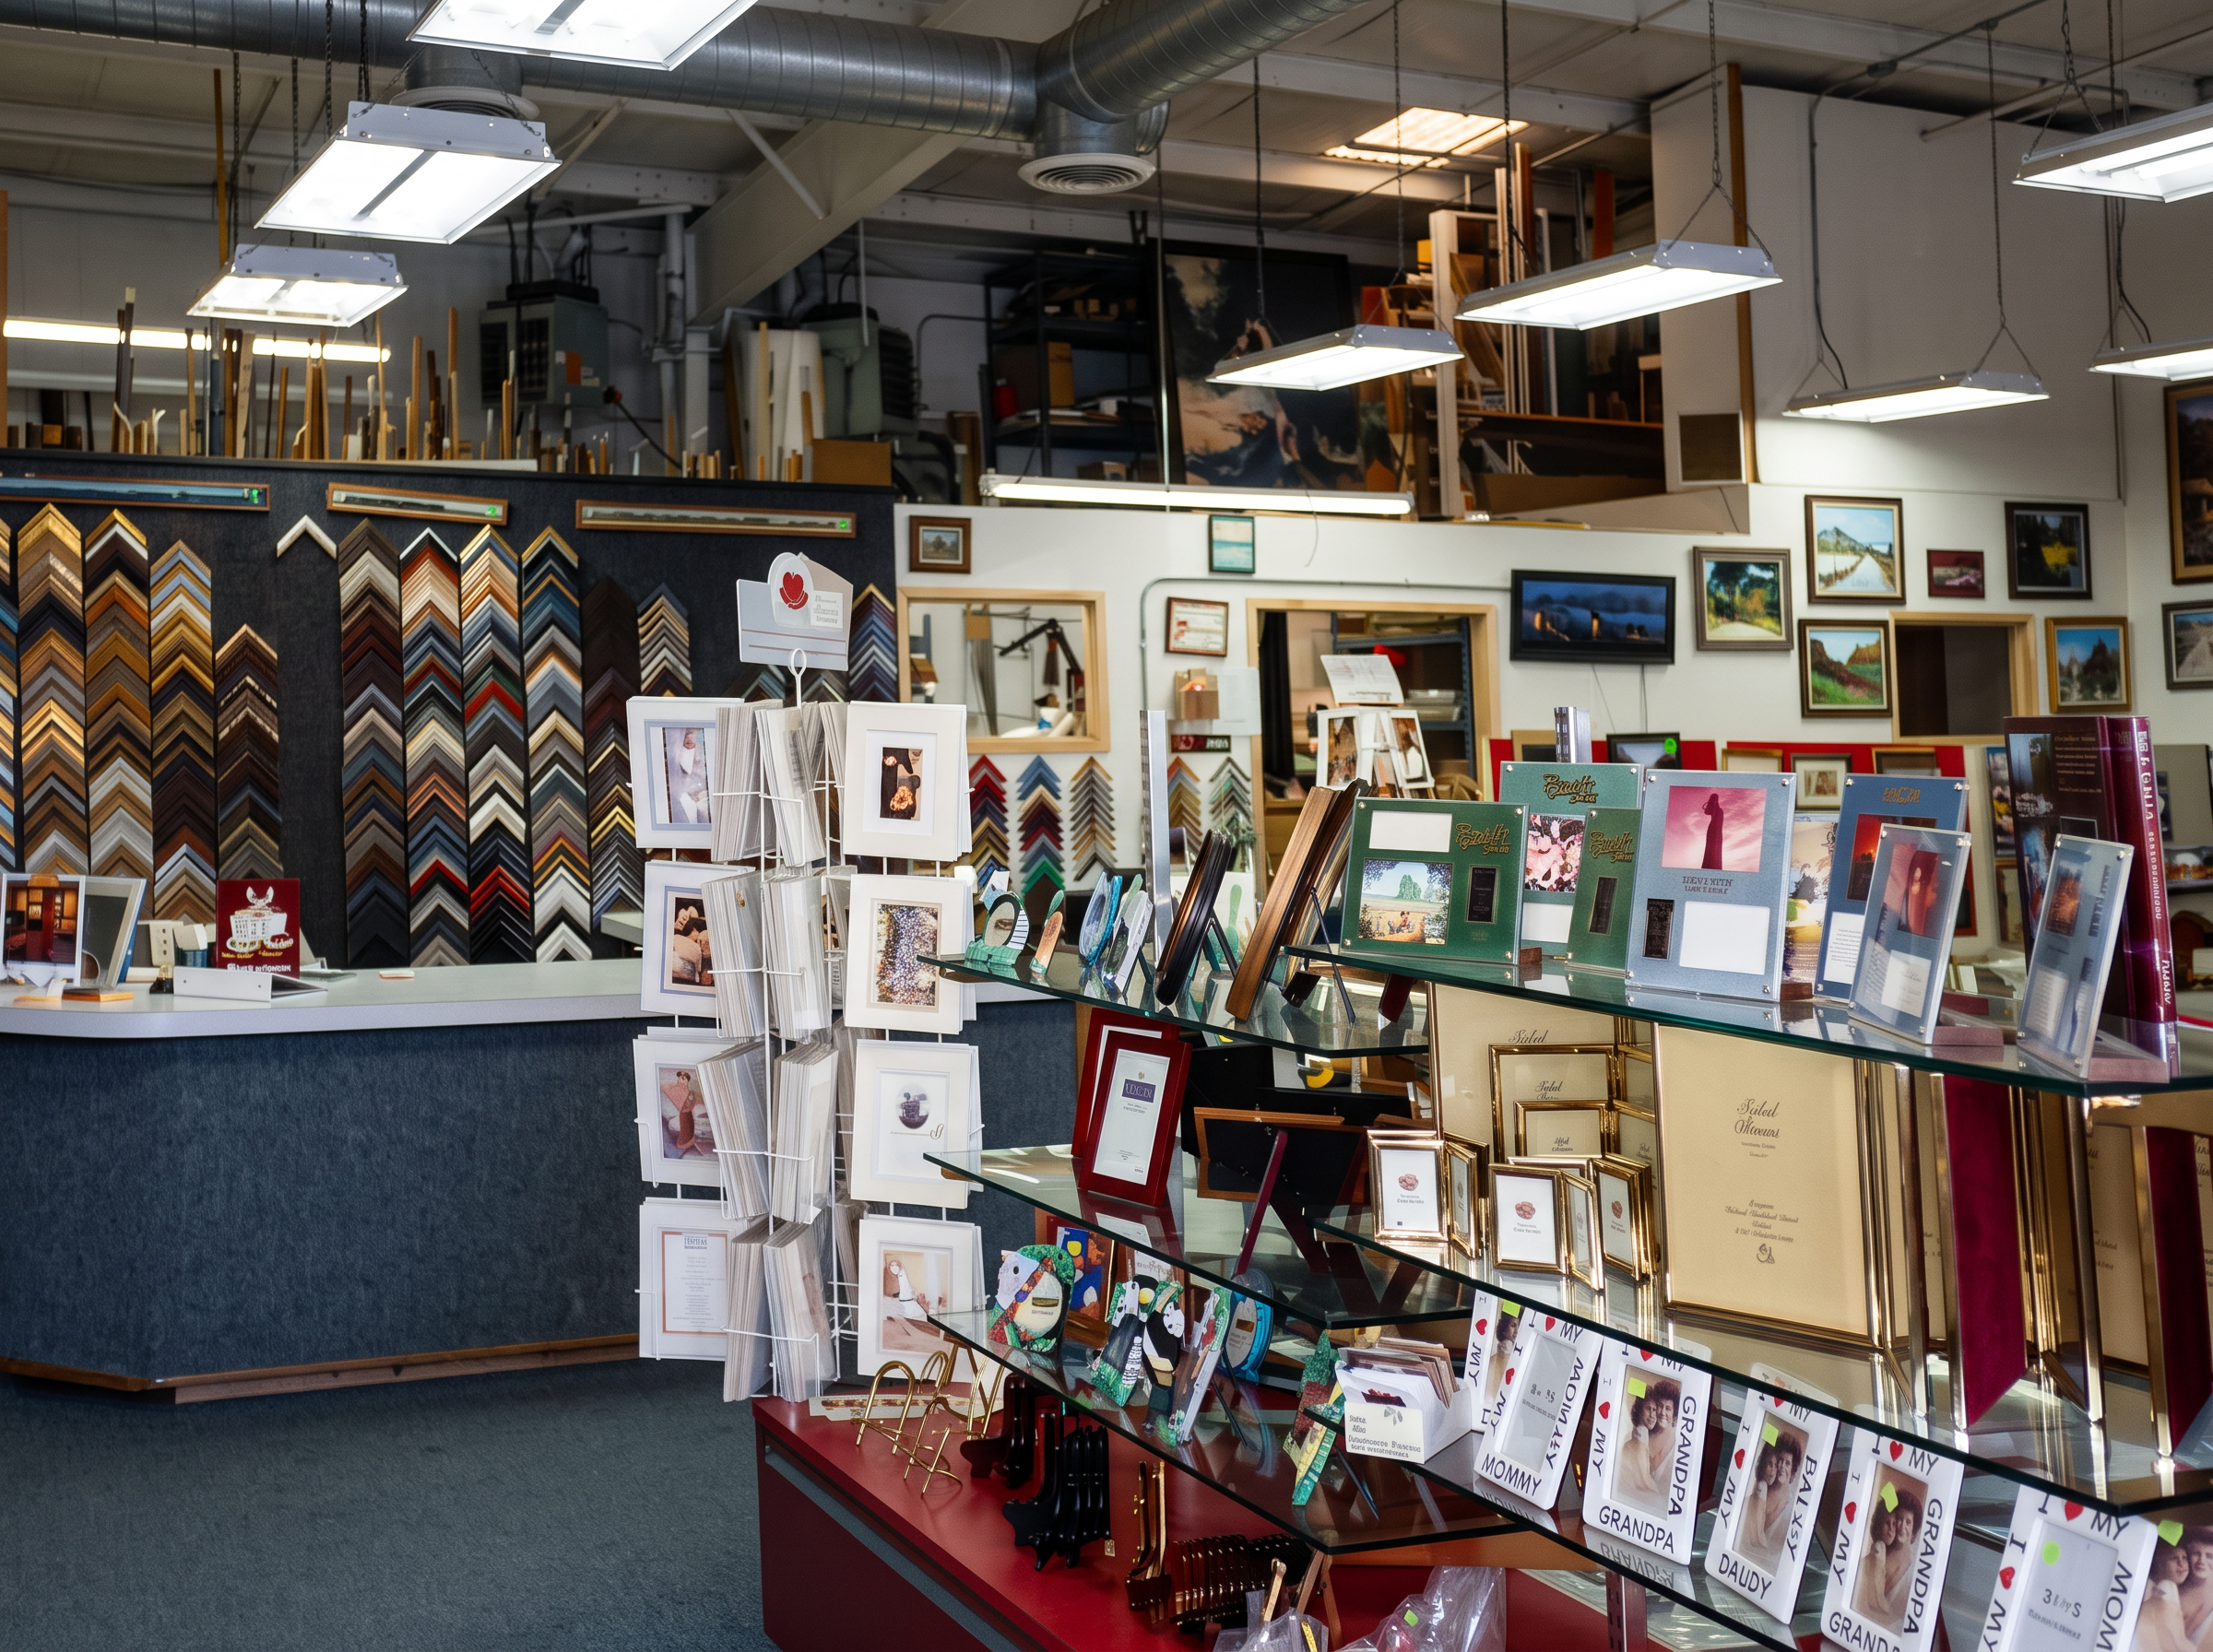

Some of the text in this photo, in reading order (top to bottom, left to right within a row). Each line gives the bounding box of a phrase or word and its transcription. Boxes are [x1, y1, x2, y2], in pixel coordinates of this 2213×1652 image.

[1559, 1321, 1584, 1344] MY
[1481, 1453, 1543, 1497] MOMMY
[1668, 1396, 1697, 1516] GRANDPA
[1871, 1434, 1939, 1476] I MY
[1599, 1505, 1675, 1554] GRANDPA
[2089, 1511, 2131, 1541] MY
[1718, 1553, 1772, 1599] DAUDY
[1903, 1498, 1943, 1634] GRANDPA
